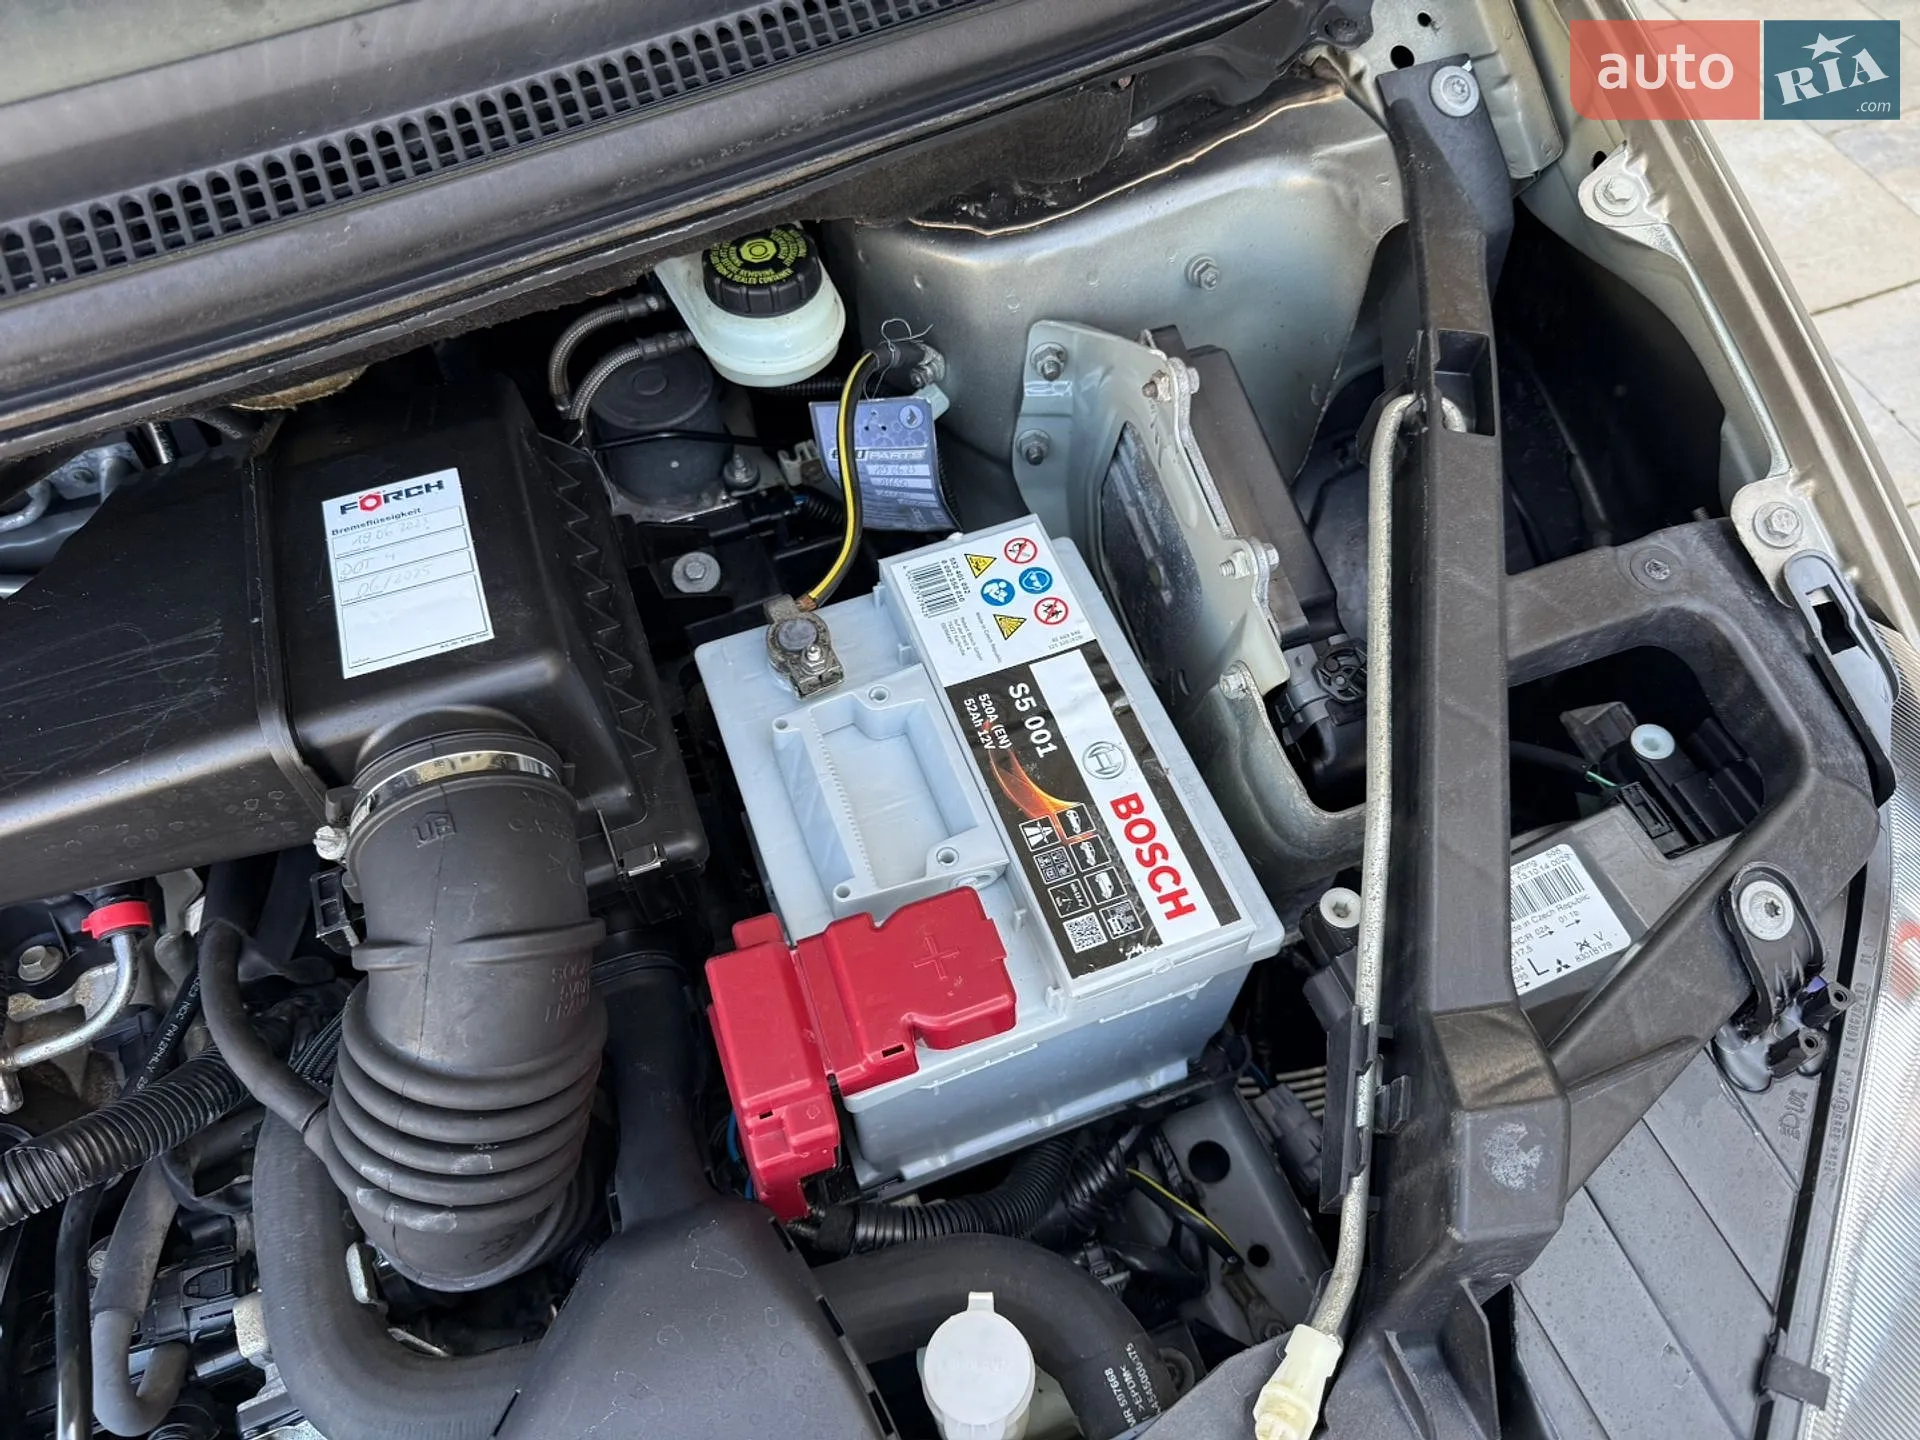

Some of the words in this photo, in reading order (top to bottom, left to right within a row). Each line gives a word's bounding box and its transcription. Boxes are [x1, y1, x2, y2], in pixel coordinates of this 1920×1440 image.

[340, 480, 445, 515] FÖRCH
[331, 507, 422, 536] Bremsflüssigkeit
[963, 698, 985, 728] 52Ah
[977, 729, 996, 749] 12V
[978, 693, 999, 723] 520A
[990, 724, 1013, 749] (EN)
[1008, 682, 1037, 712] S5
[1024, 715, 1058, 758] 001
[1110, 792, 1197, 920] BOSCH
[1555, 893, 1591, 912] Republic
[1104, 1367, 1128, 1408] 507668
